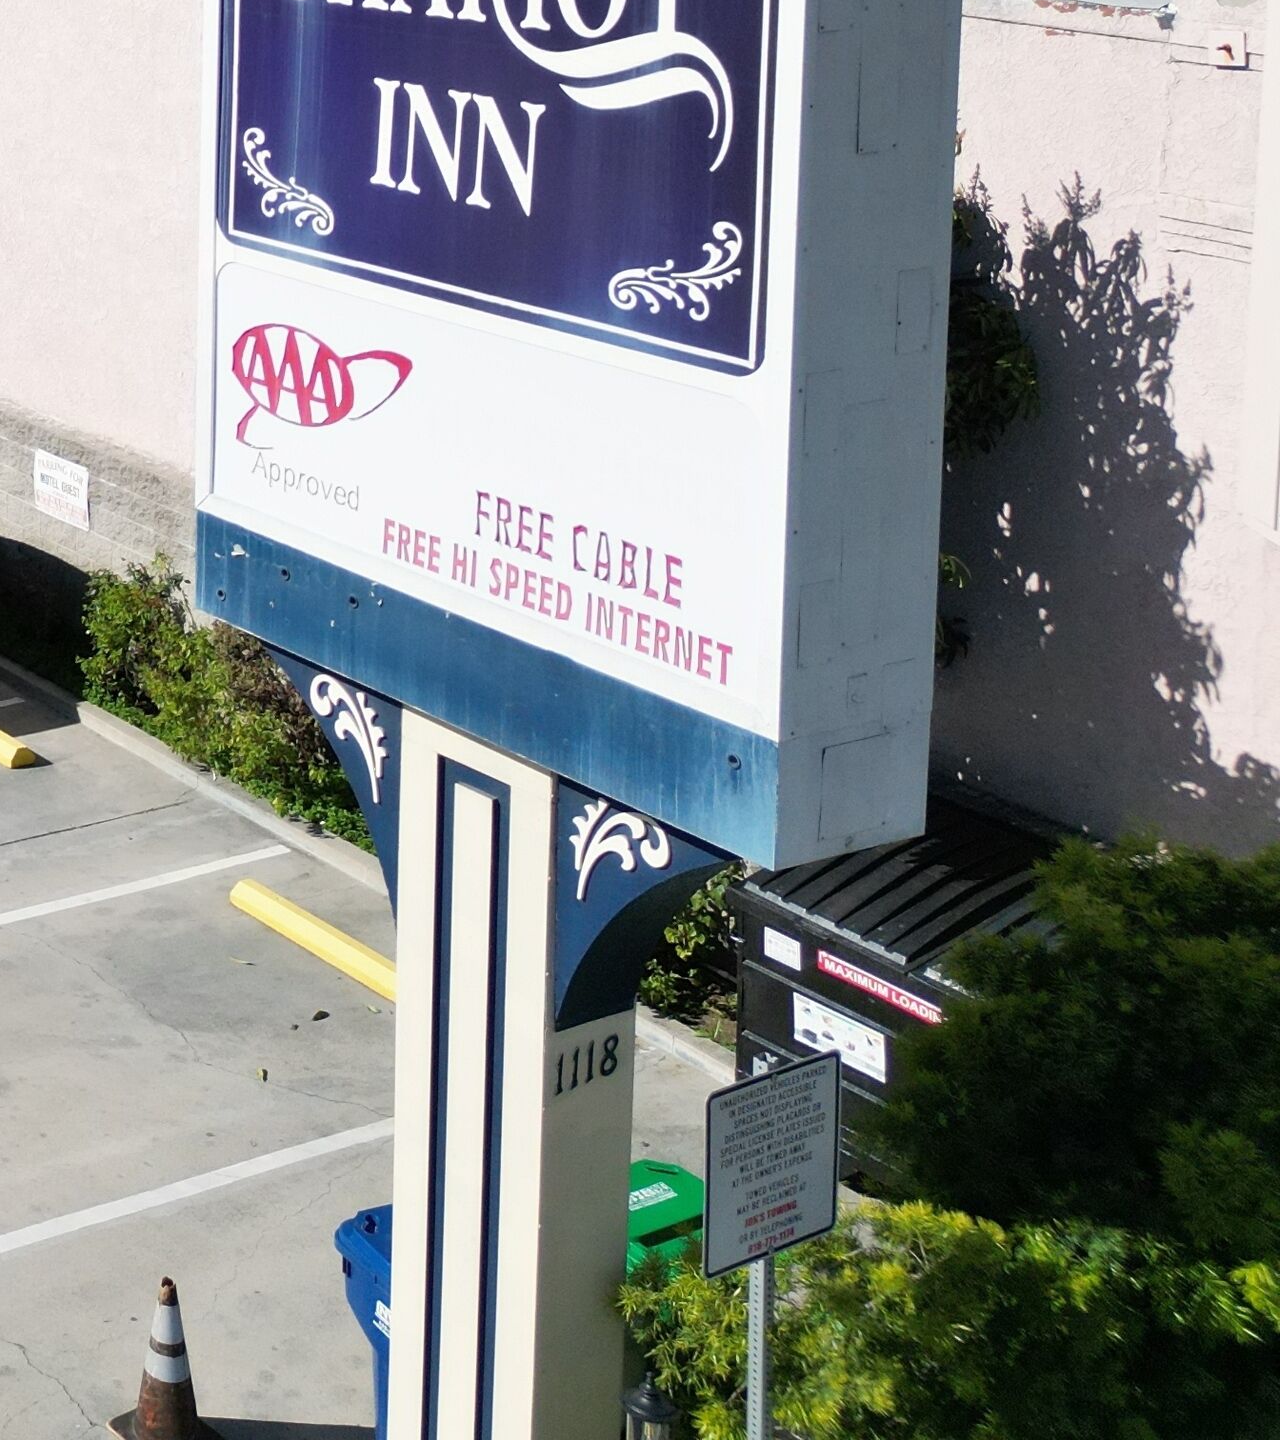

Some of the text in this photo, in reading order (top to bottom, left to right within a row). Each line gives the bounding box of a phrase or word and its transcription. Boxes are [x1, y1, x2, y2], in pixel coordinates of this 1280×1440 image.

[369, 77, 546, 217] INN
[233, 324, 354, 427] AAA
[250, 451, 361, 512] Approved
[474, 489, 684, 611] FREE CABLE
[382, 517, 735, 687] FREE HI SPEED INTERNET
[823, 958, 946, 1023] MAXIMUM LOADIN
[553, 1033, 620, 1097] 1118
[738, 1094, 776, 1115] DESIGNATED
[778, 1080, 816, 1100] ACCESSIBLE
